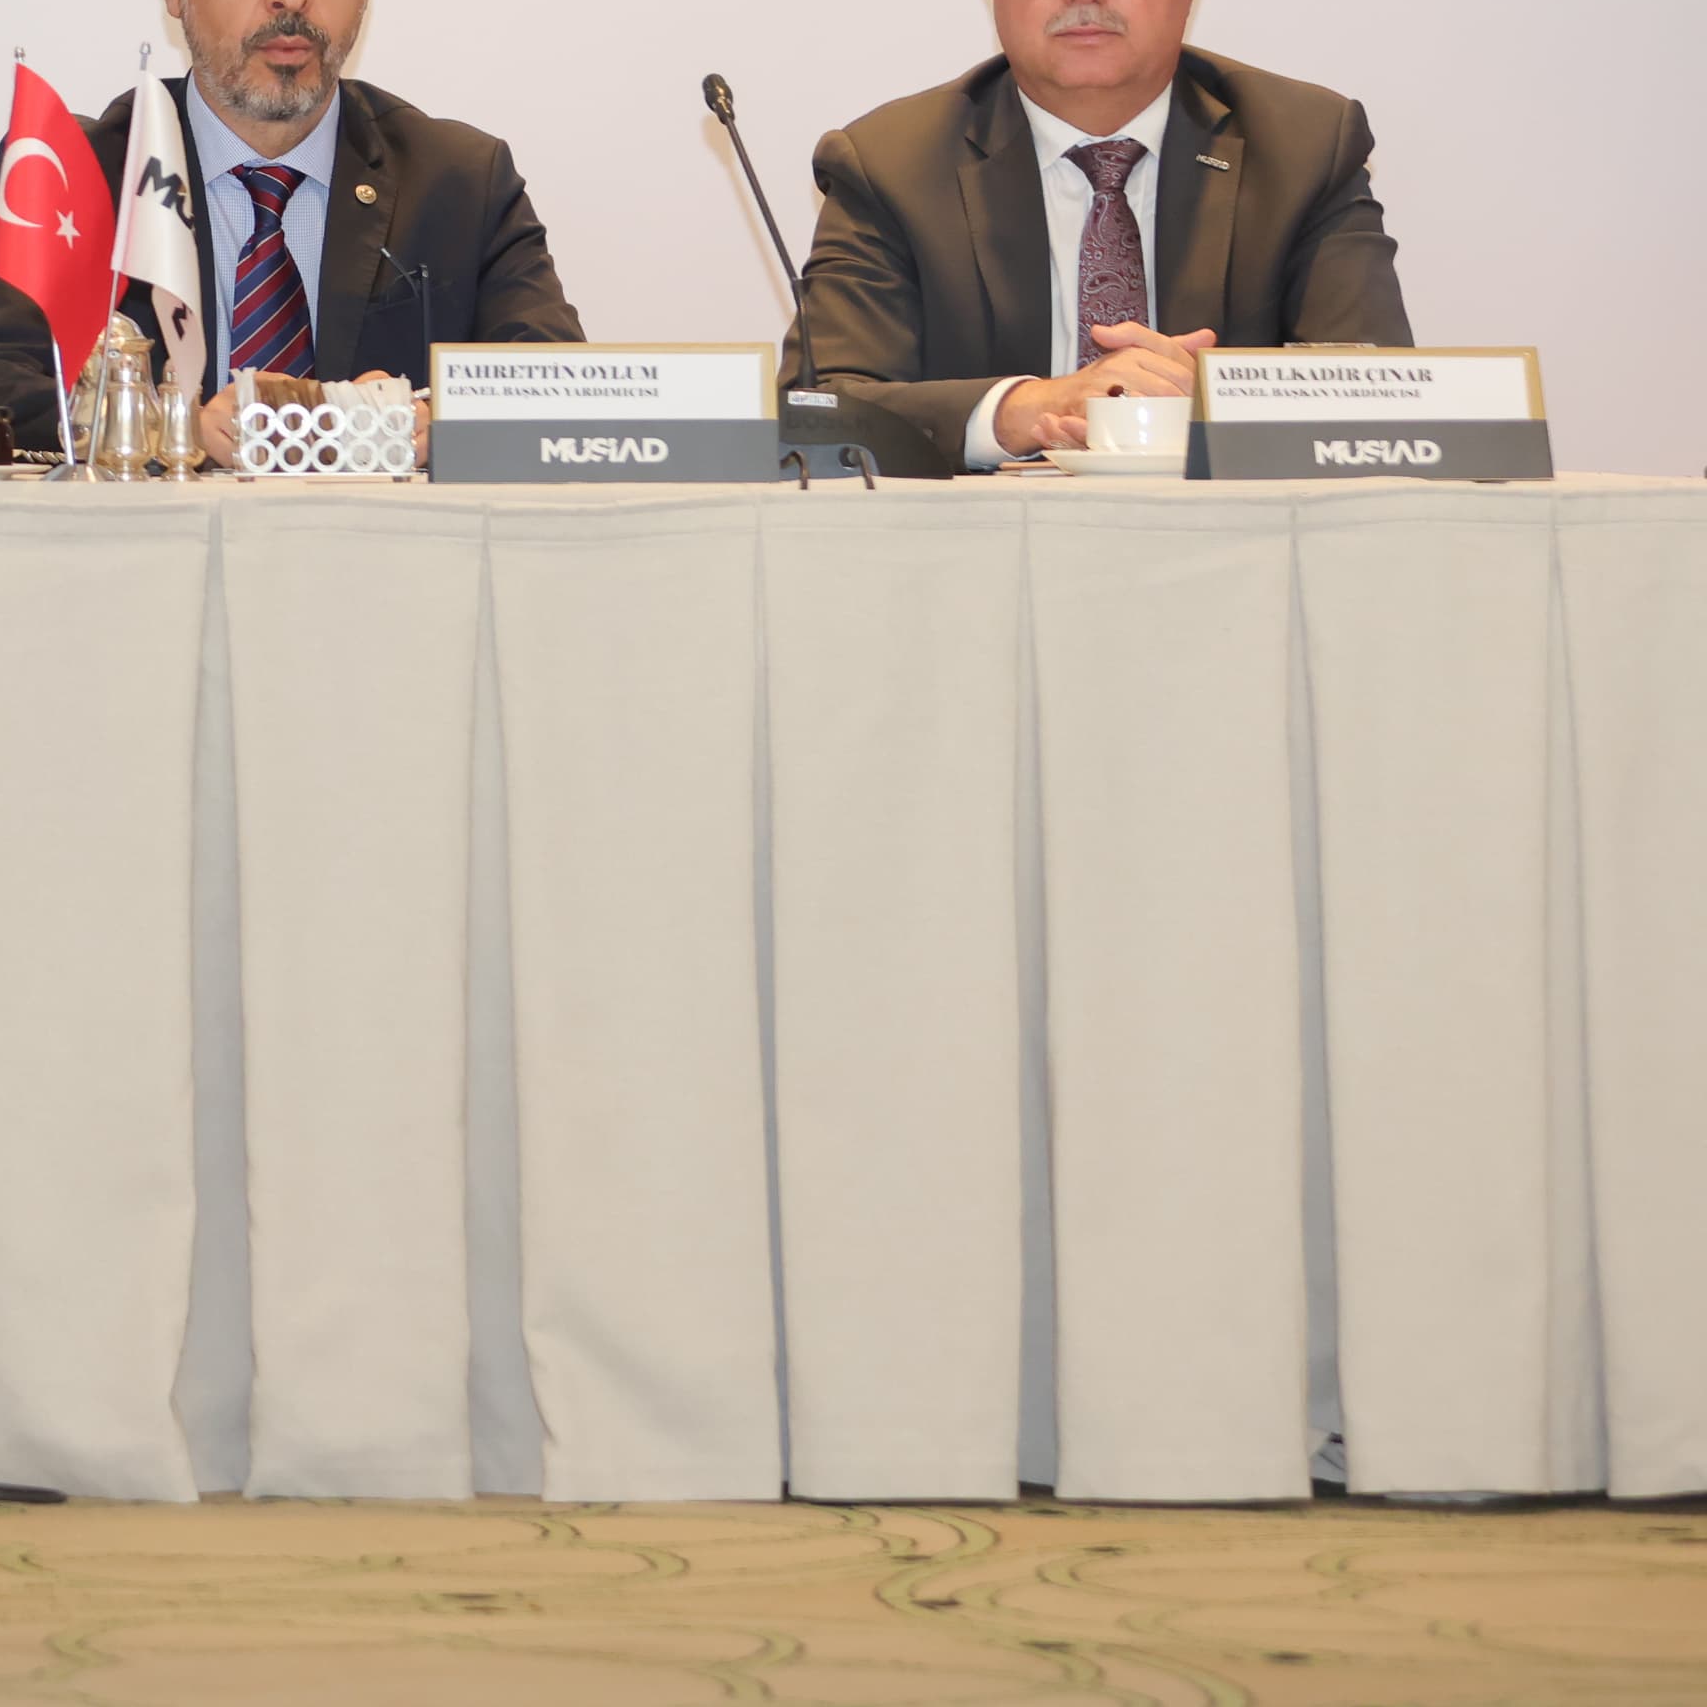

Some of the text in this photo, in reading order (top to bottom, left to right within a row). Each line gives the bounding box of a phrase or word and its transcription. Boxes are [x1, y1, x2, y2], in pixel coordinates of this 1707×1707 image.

[581, 364, 659, 381] OYLUM
[447, 385, 500, 397] GENEL
[1216, 387, 1269, 398] GENEL
